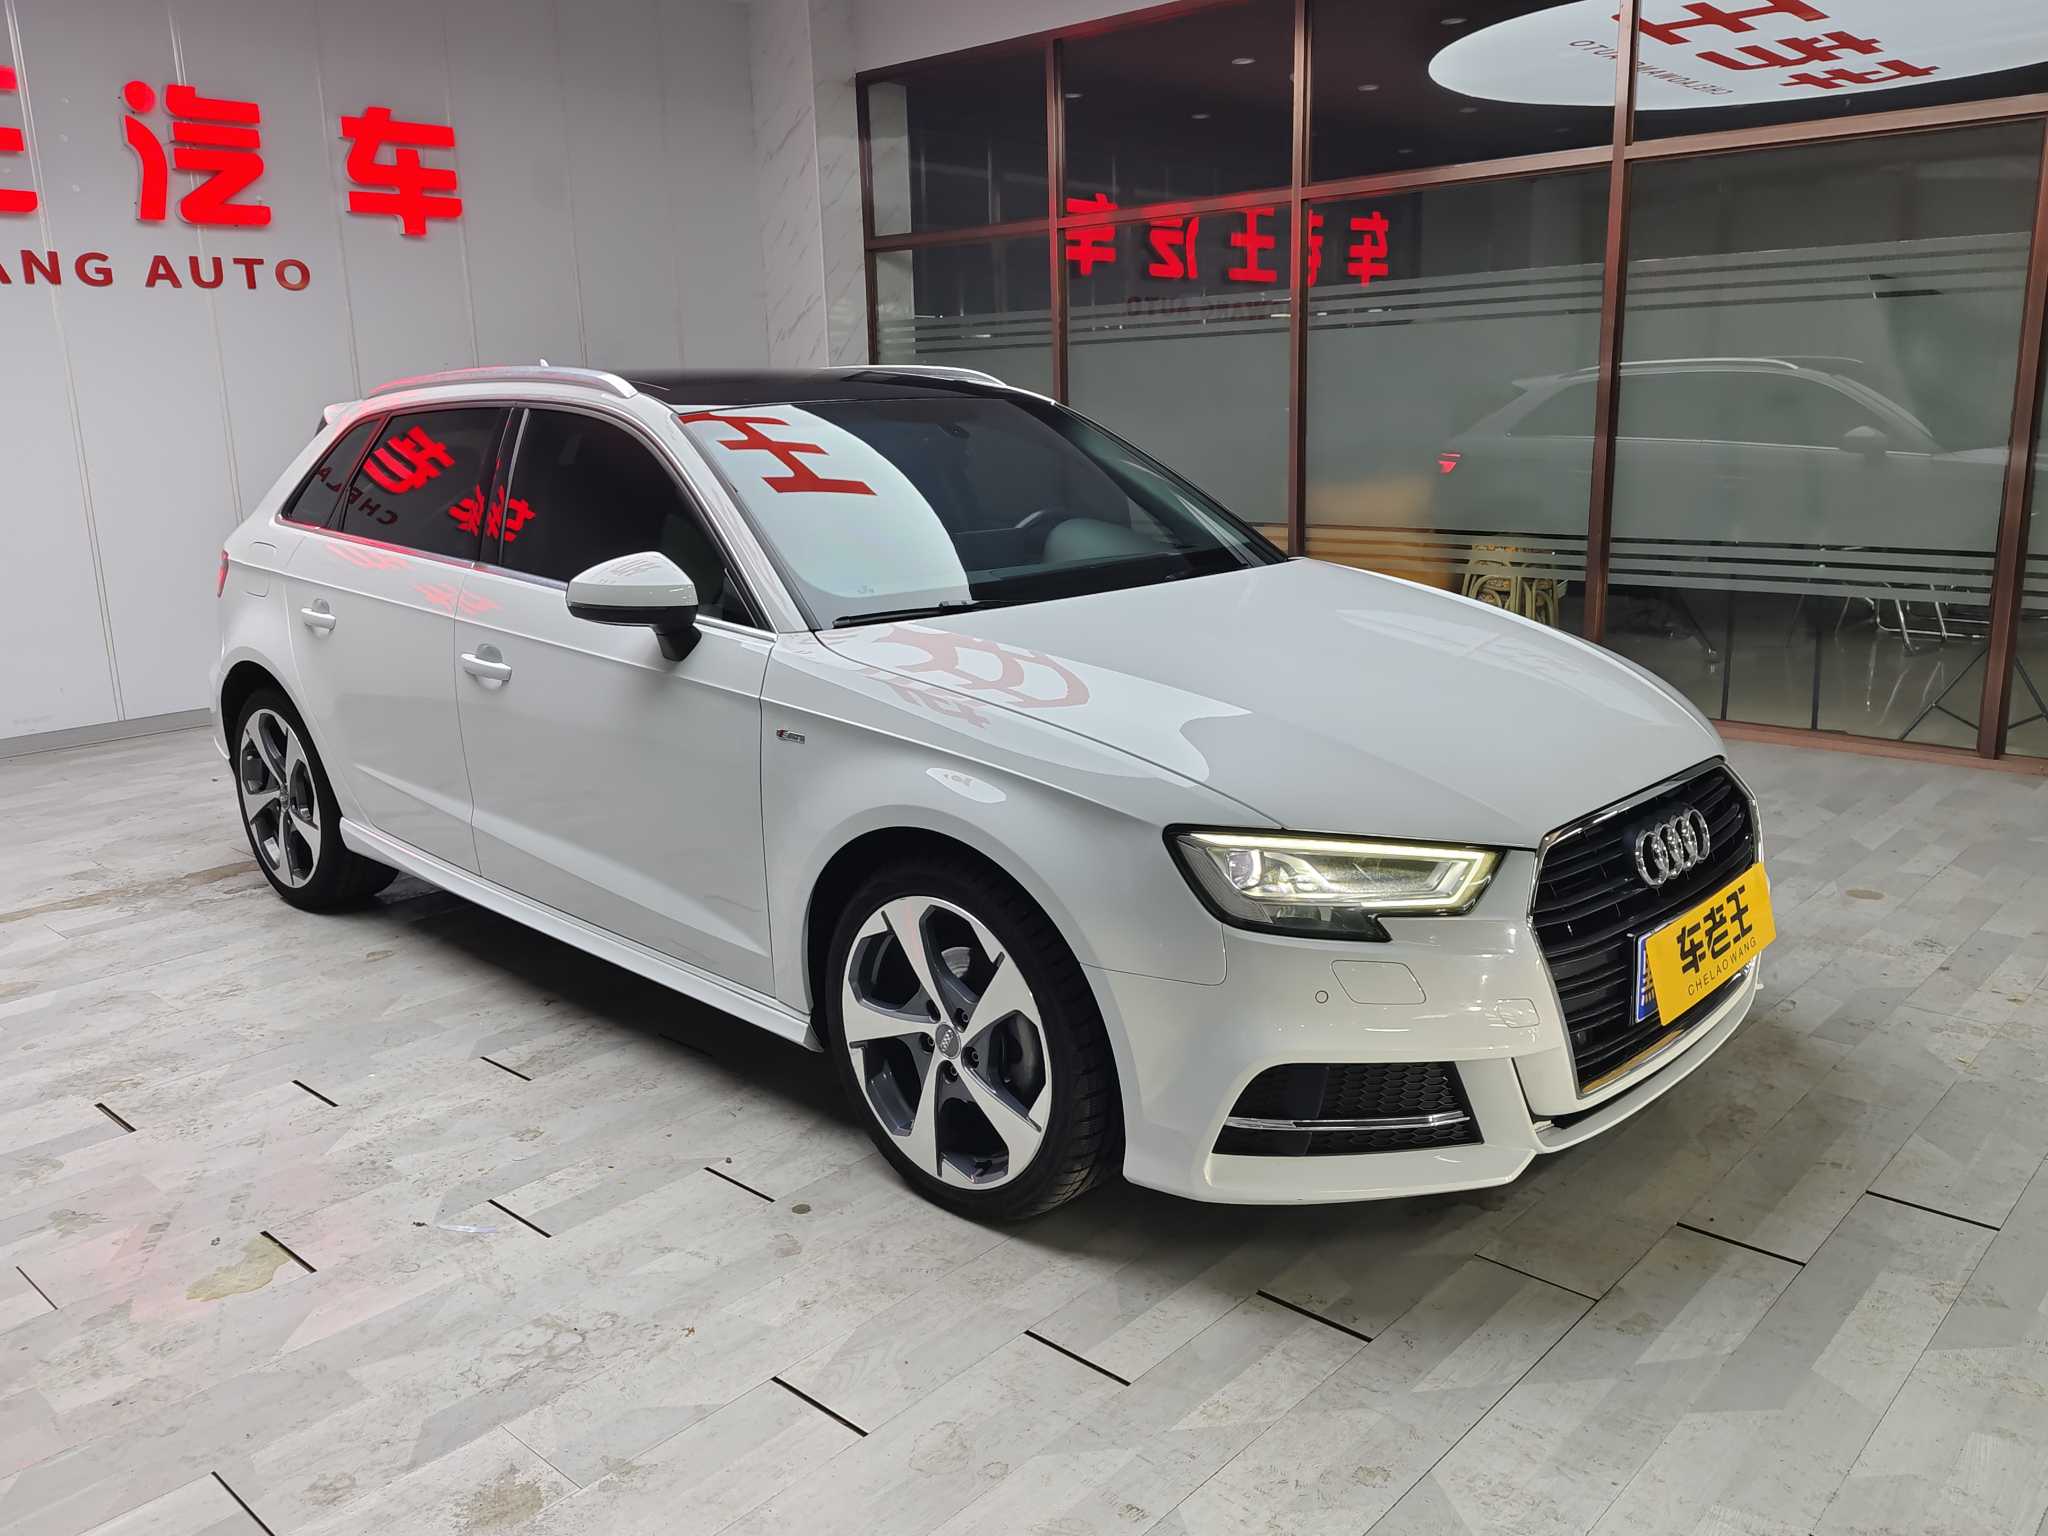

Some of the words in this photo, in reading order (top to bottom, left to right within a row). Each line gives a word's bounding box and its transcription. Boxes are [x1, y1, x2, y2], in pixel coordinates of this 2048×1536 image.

[145, 255, 311, 291] AUTO
[1676, 885, 1753, 974] 车老王
[1687, 936, 1757, 996] CHELAOWANG
